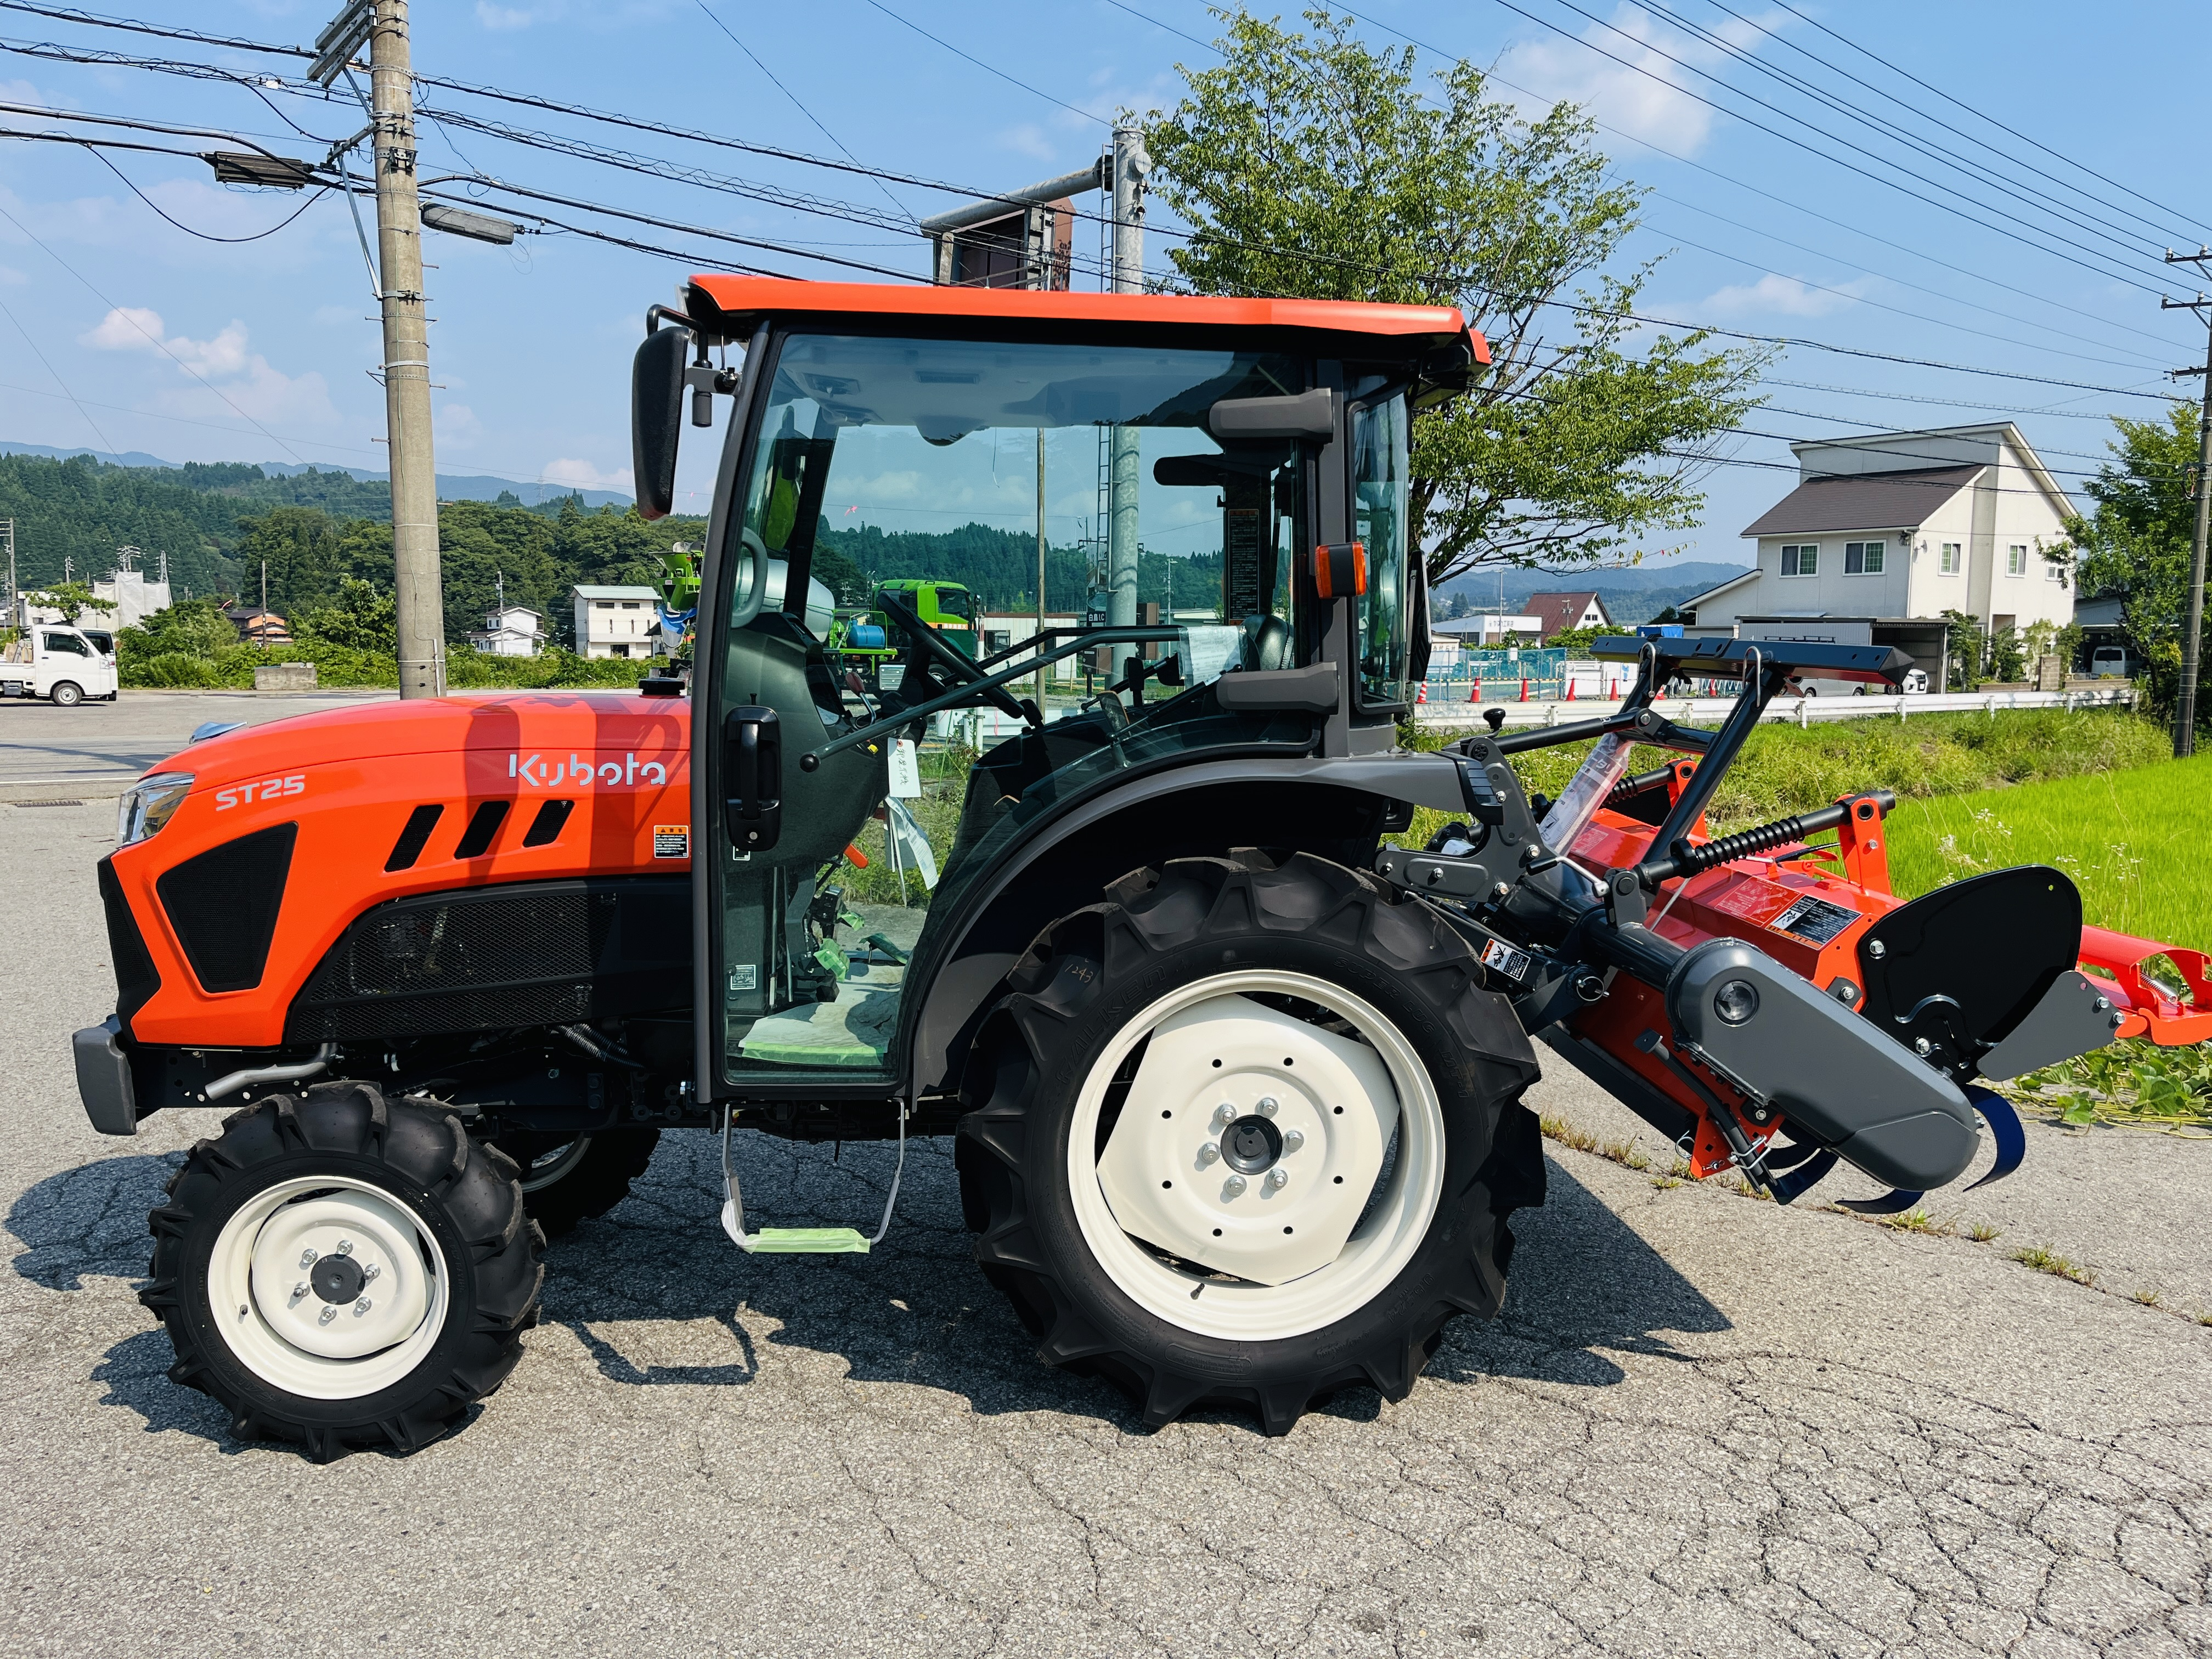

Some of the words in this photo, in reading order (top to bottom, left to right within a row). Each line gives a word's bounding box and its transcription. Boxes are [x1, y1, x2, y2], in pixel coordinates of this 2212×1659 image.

[509, 753, 666, 787] Kubota
[216, 775, 305, 811] ST25
[1064, 964, 1093, 983] 1243
[1333, 956, 1401, 1000] SUPER
[1402, 1000, 1436, 1034] LUG
